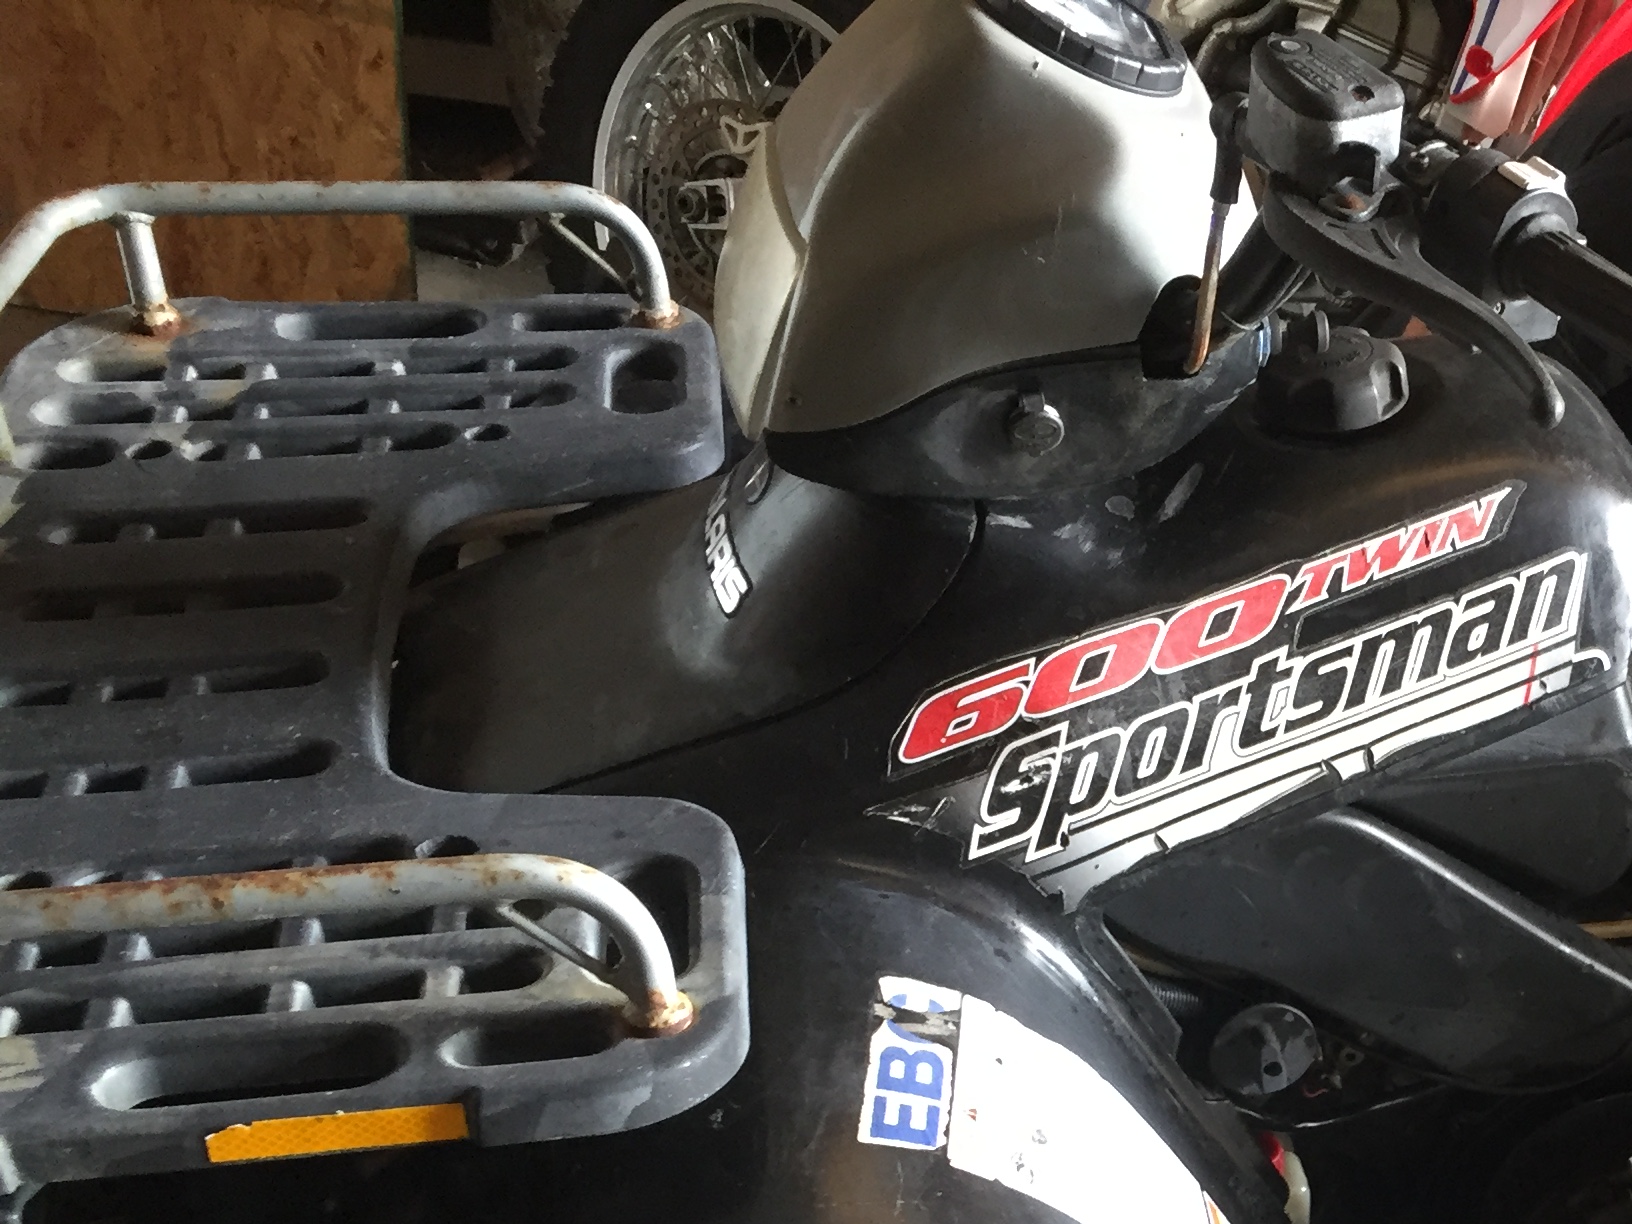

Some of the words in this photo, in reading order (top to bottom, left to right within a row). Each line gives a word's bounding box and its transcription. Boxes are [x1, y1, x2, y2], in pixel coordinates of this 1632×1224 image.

[896, 573, 1294, 764] 600
[1287, 487, 1513, 614] TWIN
[968, 551, 1582, 862] Sportsman
